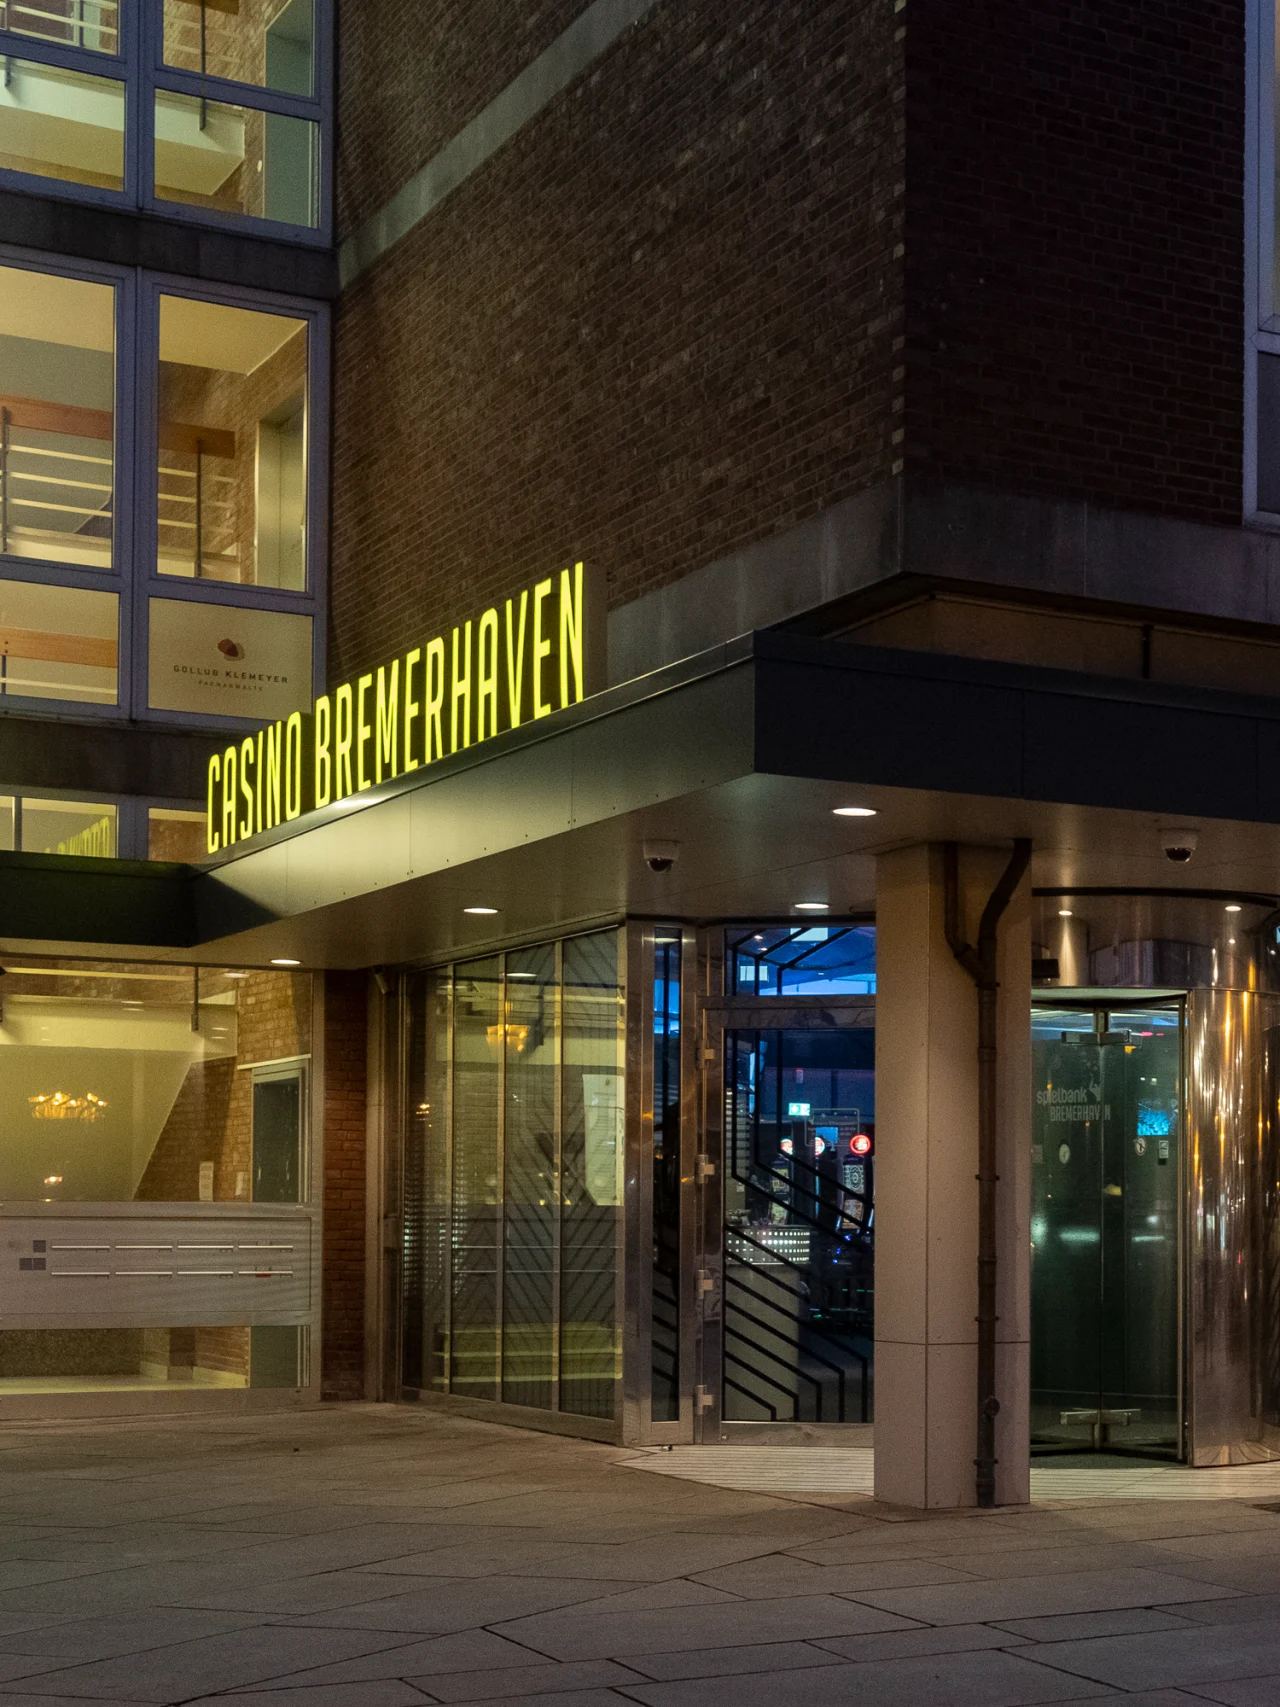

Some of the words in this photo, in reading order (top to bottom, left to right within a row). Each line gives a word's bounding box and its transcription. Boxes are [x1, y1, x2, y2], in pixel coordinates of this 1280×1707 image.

[173, 665, 219, 676] GOLLUB
[225, 670, 288, 684] KLEMEYER
[206, 711, 302, 854] CASINO
[314, 561, 585, 810] BREMERHAVEN
[1050, 1105, 1110, 1121] BREMERHAVN
